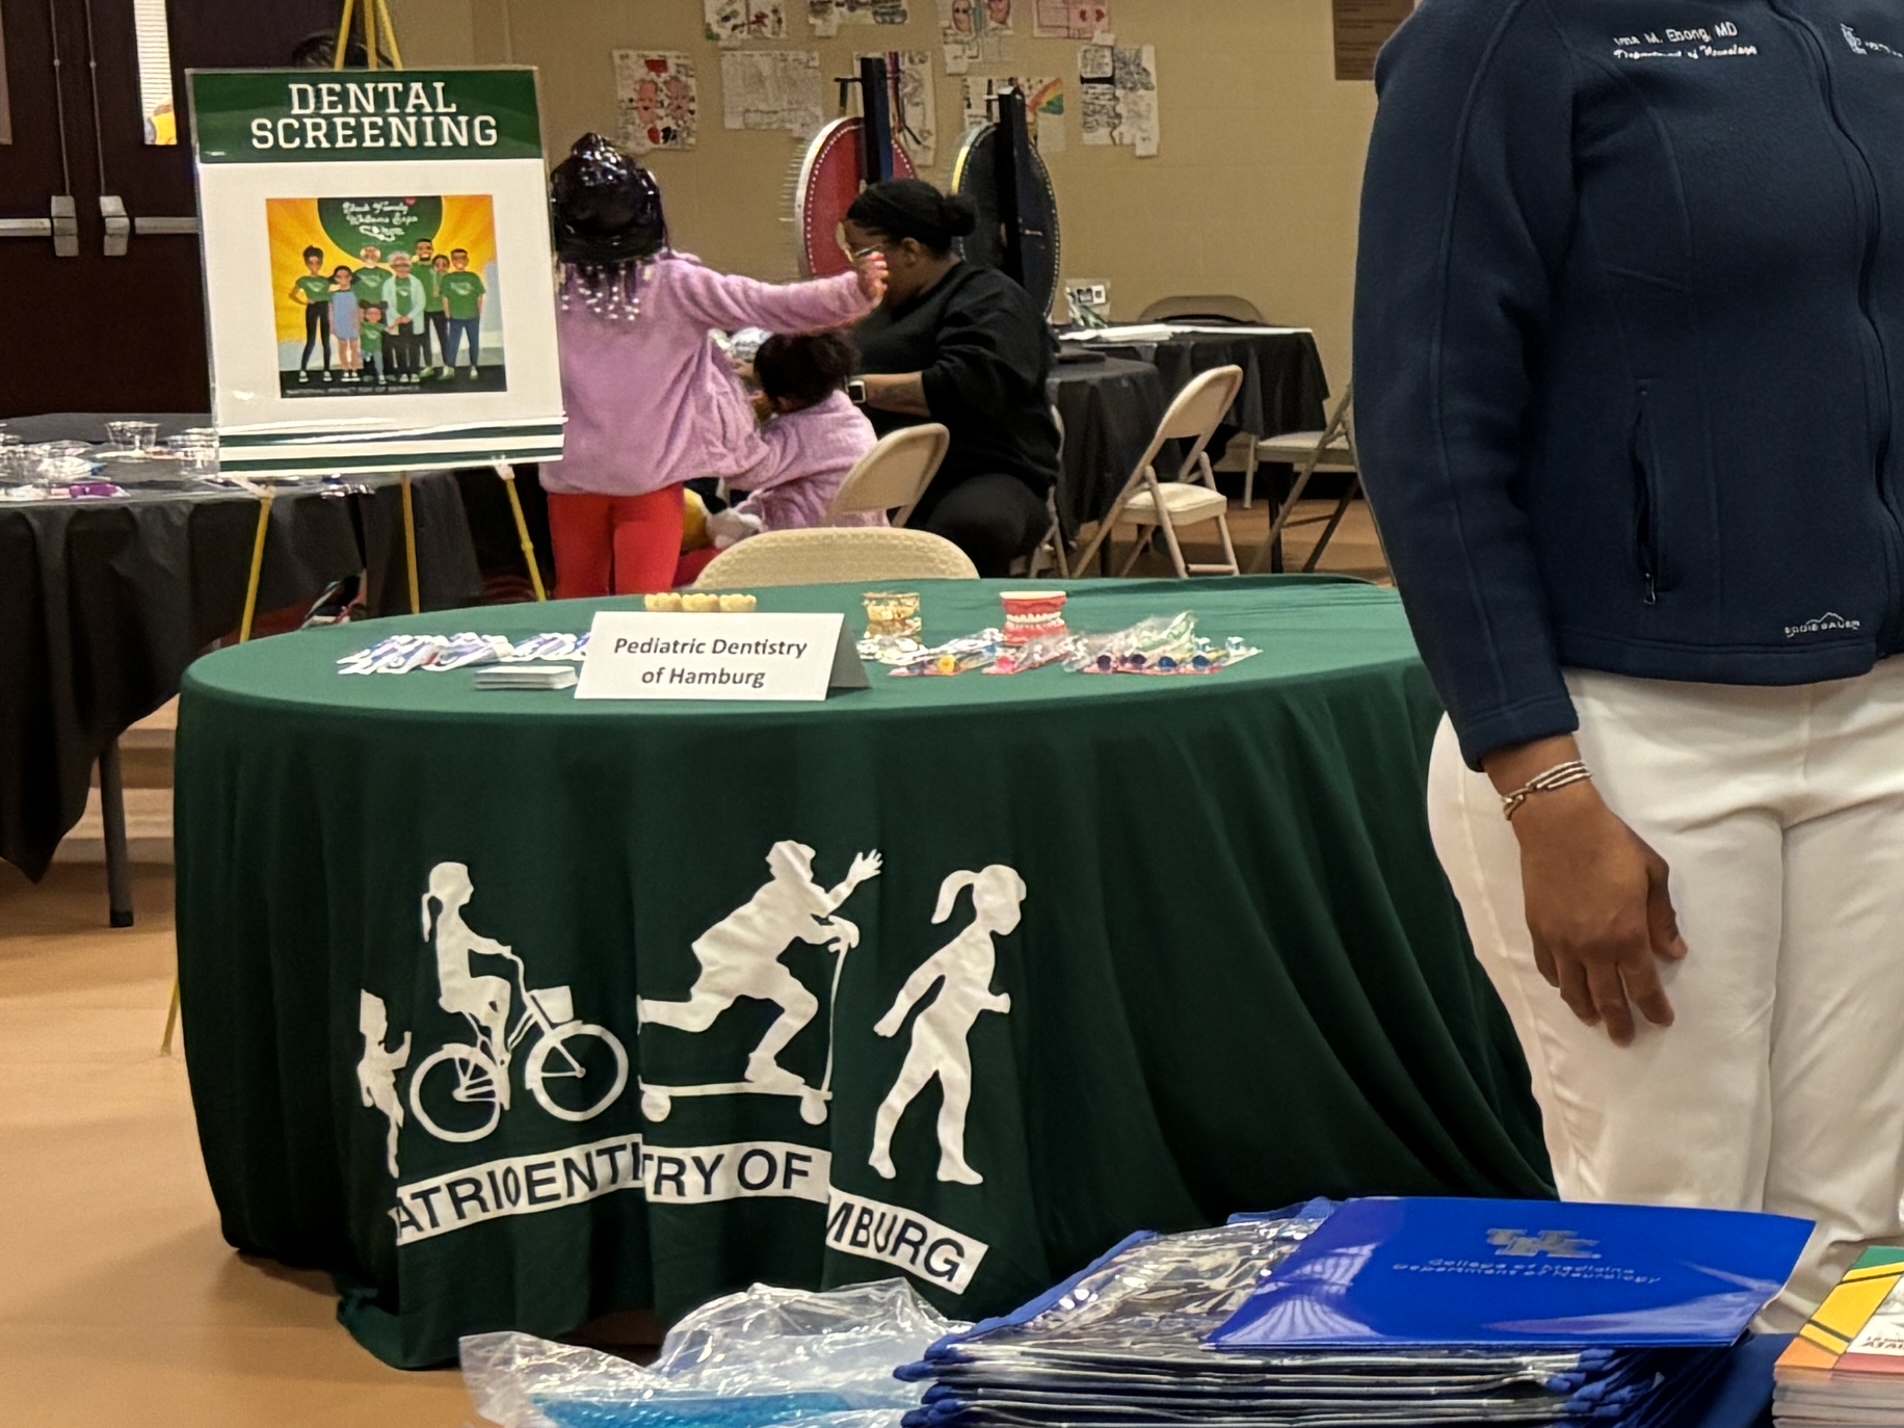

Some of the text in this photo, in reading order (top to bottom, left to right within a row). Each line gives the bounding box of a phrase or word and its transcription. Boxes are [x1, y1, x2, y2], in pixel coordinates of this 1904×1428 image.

[1714, 21, 1738, 38] MD
[288, 79, 460, 118] DENTAL
[250, 115, 500, 151] SCREENING
[613, 637, 808, 659] Pediatric Dentistry
[641, 666, 766, 689] of Hamburg
[736, 1147, 813, 1192] OF
